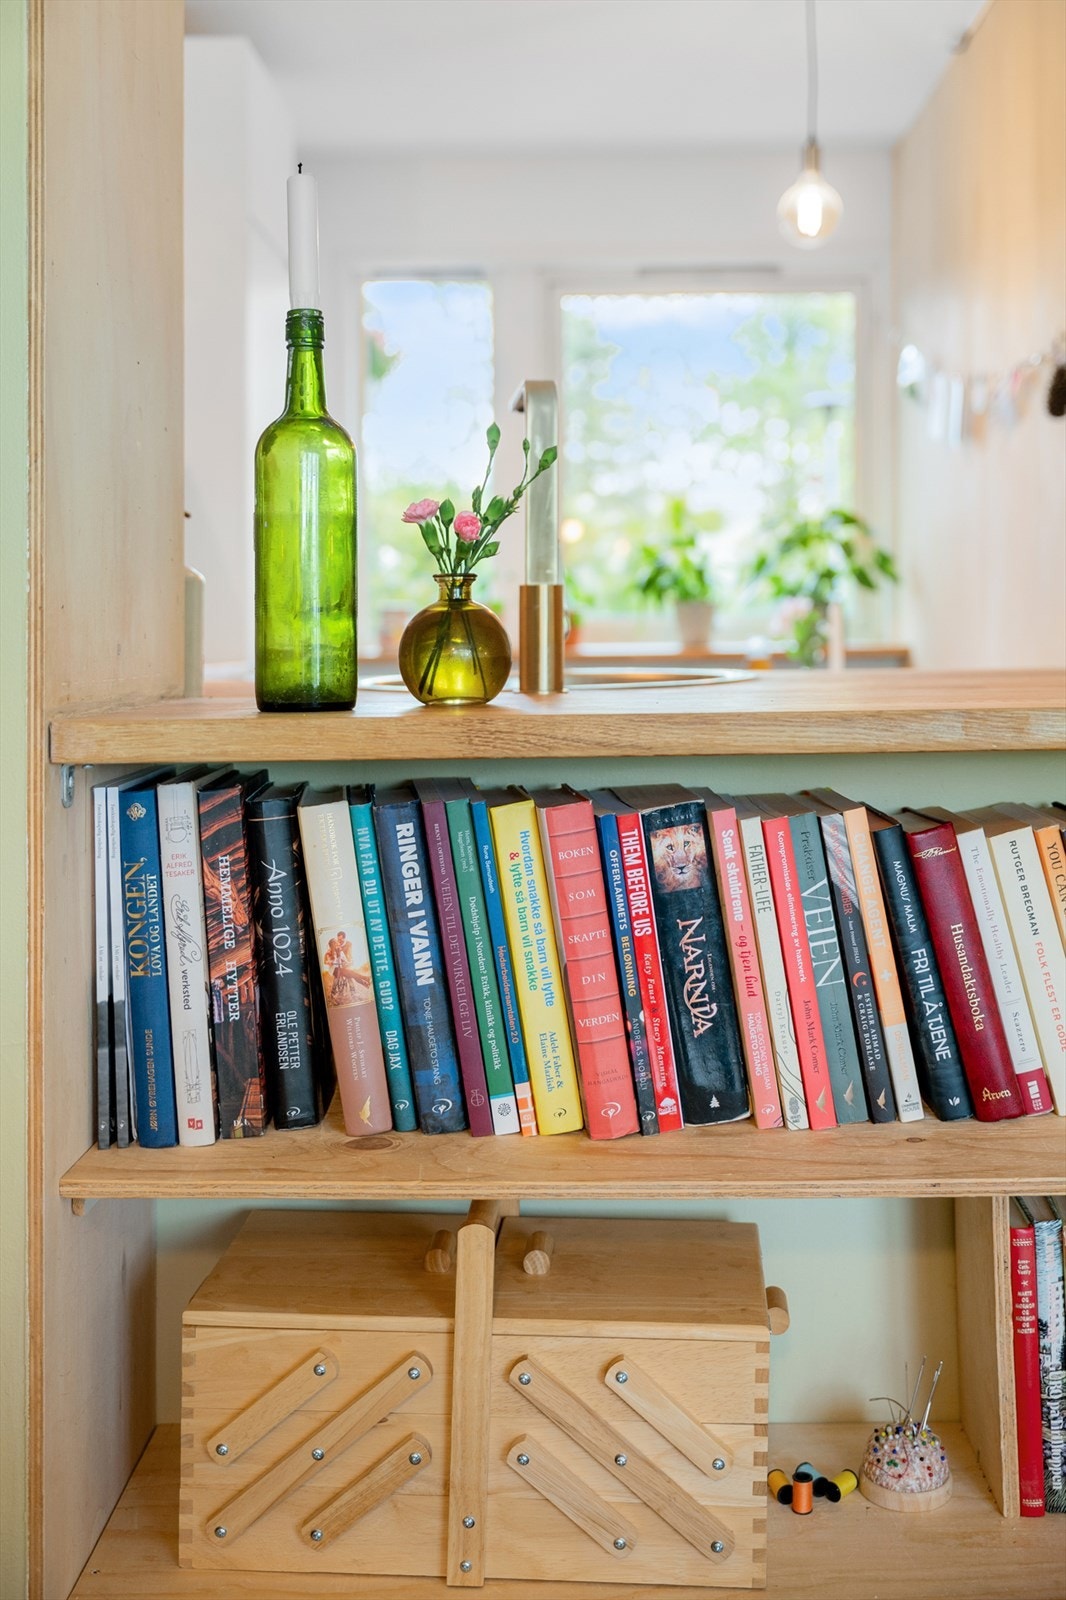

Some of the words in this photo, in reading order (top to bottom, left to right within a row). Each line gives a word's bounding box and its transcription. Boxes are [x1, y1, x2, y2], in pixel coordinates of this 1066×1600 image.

[671, 813, 694, 822] LEWIS
[357, 827, 371, 850] HVA
[621, 829, 641, 866] THEM
[722, 829, 735, 860] Senk
[166, 860, 193, 869] ALFRED
[361, 853, 377, 875] FÅR
[396, 822, 425, 907] RINGER
[509, 851, 520, 861] &
[520, 830, 535, 877] Hvordan
[558, 846, 594, 860] BOKEN
[801, 831, 816, 881] Praktiser
[1047, 842, 1063, 870] YOU
[165, 869, 195, 878] TESAKER
[509, 863, 524, 888] lytte
[748, 844, 772, 914] FATHER-LIFE
[146, 874, 160, 922] LANDET
[261, 859, 288, 919] Anno
[363, 879, 378, 897] DU
[440, 877, 454, 911] VEIEN
[515, 889, 525, 904] så
[527, 879, 541, 919] snakke
[568, 889, 596, 901] SOM
[627, 868, 650, 917] BEFORE
[726, 862, 744, 922] skuldrene
[854, 832, 876, 895] CHANGE
[866, 899, 887, 948] AGENT
[893, 860, 911, 902] MAGNUS
[903, 904, 917, 934] MALM
[1010, 840, 1026, 882] RUTGER
[1020, 885, 1040, 936] BREGMAN
[218, 855, 236, 950] HEMMELIGE
[367, 899, 380, 915] UT
[408, 909, 426, 919] I
[469, 896, 480, 935] Dødshjelp
[777, 831, 792, 891] Kompromissløs
[786, 892, 799, 937] eliminering
[793, 938, 800, 948] av
[799, 948, 808, 983] hastverk
[124, 857, 151, 978] KONGEN,
[370, 918, 384, 932] AV
[446, 913, 457, 931] TIL
[518, 905, 528, 933] barn
[533, 919, 543, 935] så
[609, 849, 628, 931] OFFERLAMMETS
[620, 935, 637, 997] BELØNNING
[633, 918, 652, 937] US
[971, 846, 979, 865] The
[976, 867, 994, 922] Emotionally
[990, 924, 1005, 961] Healthy
[1000, 963, 1012, 995] Leader
[149, 924, 160, 943] OG
[449, 932, 461, 955] DET
[522, 934, 534, 949] vil
[568, 929, 608, 945] SKAPTE
[735, 935, 748, 949] og
[801, 877, 845, 988] VEIEN
[151, 944, 162, 976] LOVA
[272, 924, 294, 978] 1024
[373, 935, 389, 977] DETTE,
[410, 919, 435, 987] VANN
[475, 941, 487, 975] Norden?
[537, 936, 549, 964] barn
[740, 949, 752, 972] tjen
[853, 946, 861, 964] JIHAD
[911, 948, 931, 974] FRI
[524, 951, 538, 991] snakke
[540, 963, 552, 978] vil
[643, 953, 652, 976] Katy
[676, 916, 718, 1039] NARNIA
[951, 922, 985, 1032] Husandaktsboka
[181, 968, 192, 1011] verksted
[226, 960, 240, 1022] HYTTER
[452, 959, 471, 1020] VIRKELIGE
[481, 977, 490, 1000] Etikk,
[541, 979, 554, 1007] lytte
[581, 973, 606, 985] DIN
[647, 977, 657, 1004] Faust
[745, 975, 759, 998] Gud
[918, 975, 936, 999] TIL
[1035, 942, 1048, 969] FOLK
[1043, 972, 1057, 1008] FLEST
[1051, 1007, 1061, 1021] ER
[379, 980, 395, 1011] GUD?
[497, 945, 516, 1031] Medarbeidersamtalen
[510, 1030, 520, 1044] 2.0
[922, 1000, 943, 1017] Å
[287, 1010, 298, 1029] OLE
[423, 997, 434, 1022] TONJE
[484, 1000, 494, 1027] klinikk
[578, 1012, 620, 1028] VERDEN
[755, 1011, 764, 1031] TONJE
[803, 1000, 812, 1020] John
[830, 1002, 838, 1022] John
[858, 1002, 869, 1030] CRAIG
[385, 1030, 399, 1050] DAG
[461, 1020, 473, 1039] LIV
[486, 1027, 495, 1039] og
[632, 1018, 641, 1056] ANDREAS
[652, 1017, 661, 1045] Stacy
[747, 1013, 759, 1050] HAUGETO
[758, 1032, 766, 1044] OG
[779, 1023, 788, 1055] Krause
[806, 1021, 816, 1044] Mark
[833, 1023, 843, 1046] Mark
[863, 992, 875, 1026] ESTHER
[870, 1028, 882, 1061] AHMAD
[928, 1014, 952, 1062] TJENE
[1012, 1011, 1026, 1053] Scazzero
[144, 1029, 154, 1058] SUNDE
[276, 1012, 290, 1070] ERLANDSEN
[288, 1031, 301, 1069] PETTER
[426, 1022, 437, 1063] HAUGETO
[488, 1039, 502, 1071] politikk
[549, 1031, 557, 1053] Adele
[760, 1044, 769, 1061] DAG
[863, 1031, 876, 1071] BORLASE
[351, 1050, 359, 1080] WOOTEN
[388, 1051, 403, 1071] JAX
[431, 1062, 442, 1085] STANG
[539, 1033, 548, 1058] Elaine
[544, 1060, 553, 1092] Mazlish
[552, 1054, 561, 1079] Faber
[656, 1045, 667, 1089] Manning
[752, 1050, 763, 1077] STANG
[810, 1045, 820, 1074] Comer
[837, 1046, 848, 1076] Comer
[556, 1080, 564, 1088] &
[762, 1060, 772, 1089] WILLIAM
[982, 1087, 1012, 1101] Arven
[149, 1108, 158, 1131] JØRN
